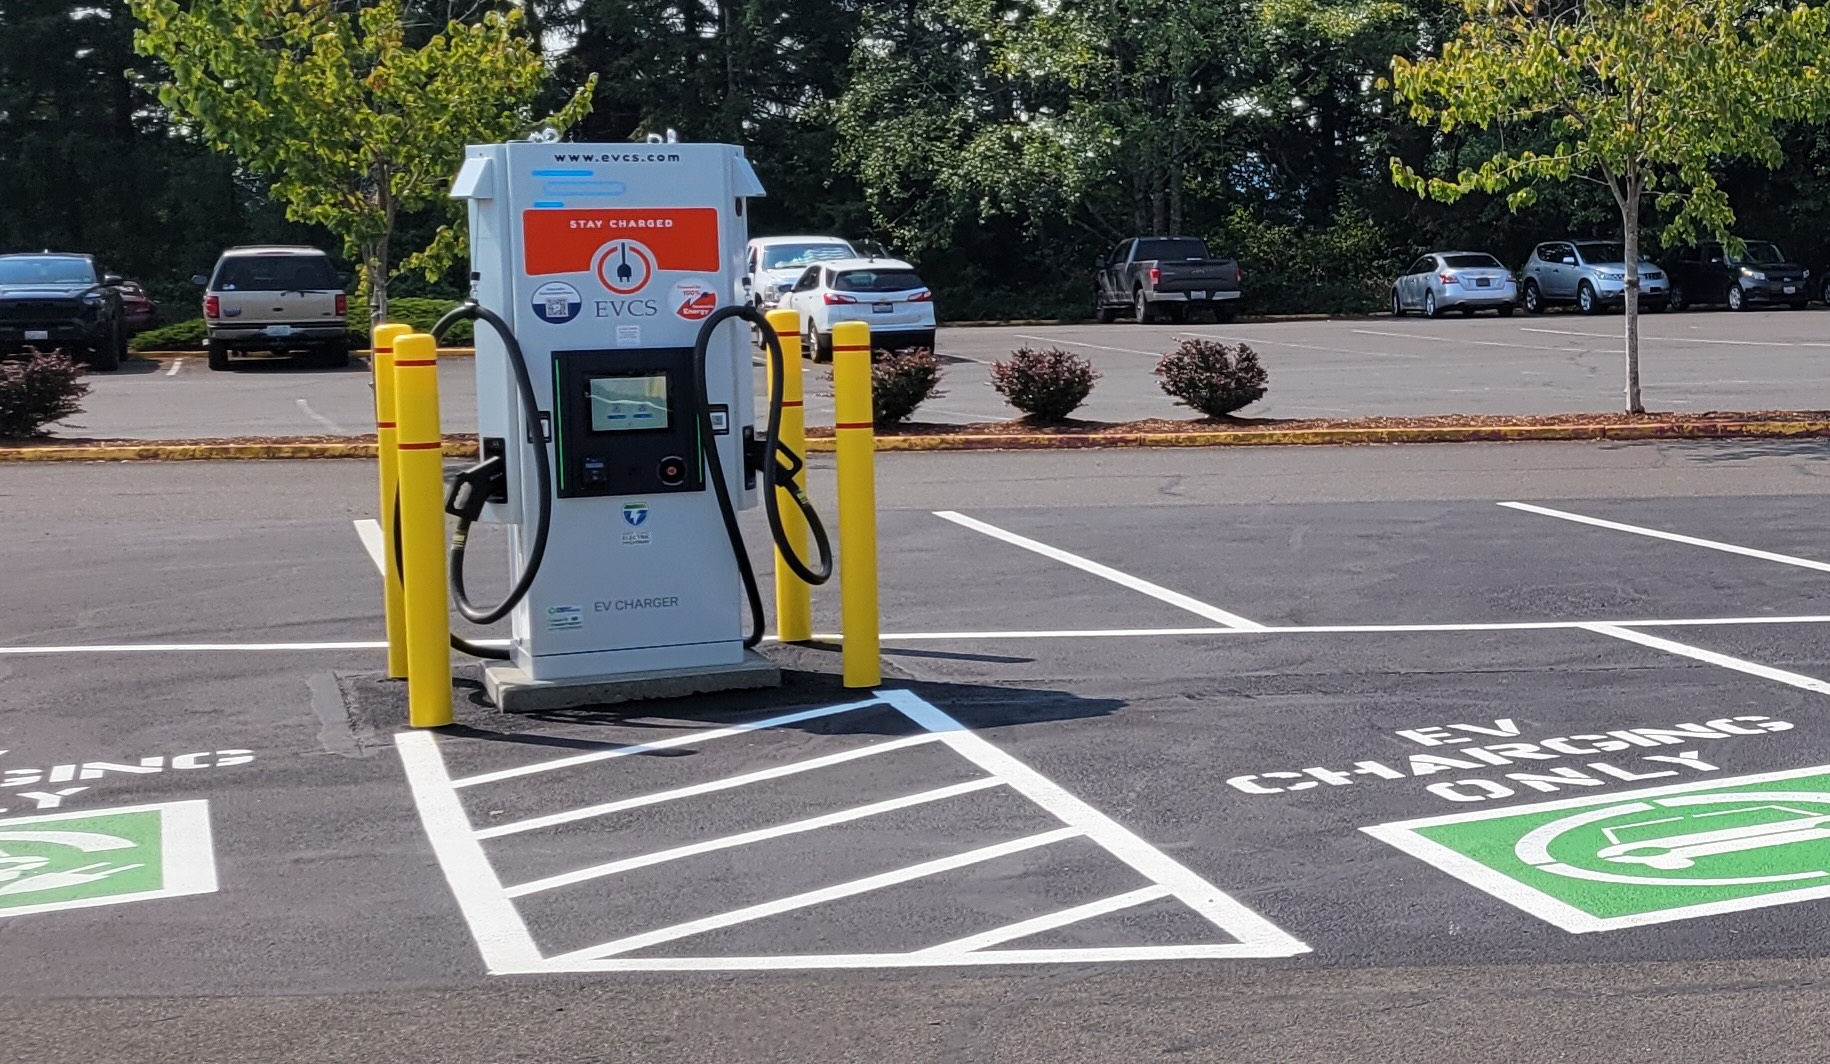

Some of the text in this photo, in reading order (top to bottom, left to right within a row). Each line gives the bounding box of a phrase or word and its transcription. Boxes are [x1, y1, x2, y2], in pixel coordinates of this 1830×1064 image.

[554, 154, 680, 163] www.evcs.com
[569, 219, 673, 229] STAY CHARGED
[594, 299, 658, 318] EVCS
[594, 596, 679, 612] EV CHARGER
[1395, 718, 1521, 746] EV
[1225, 716, 1795, 794] CHARGING
[1425, 750, 1720, 803] ONLY
